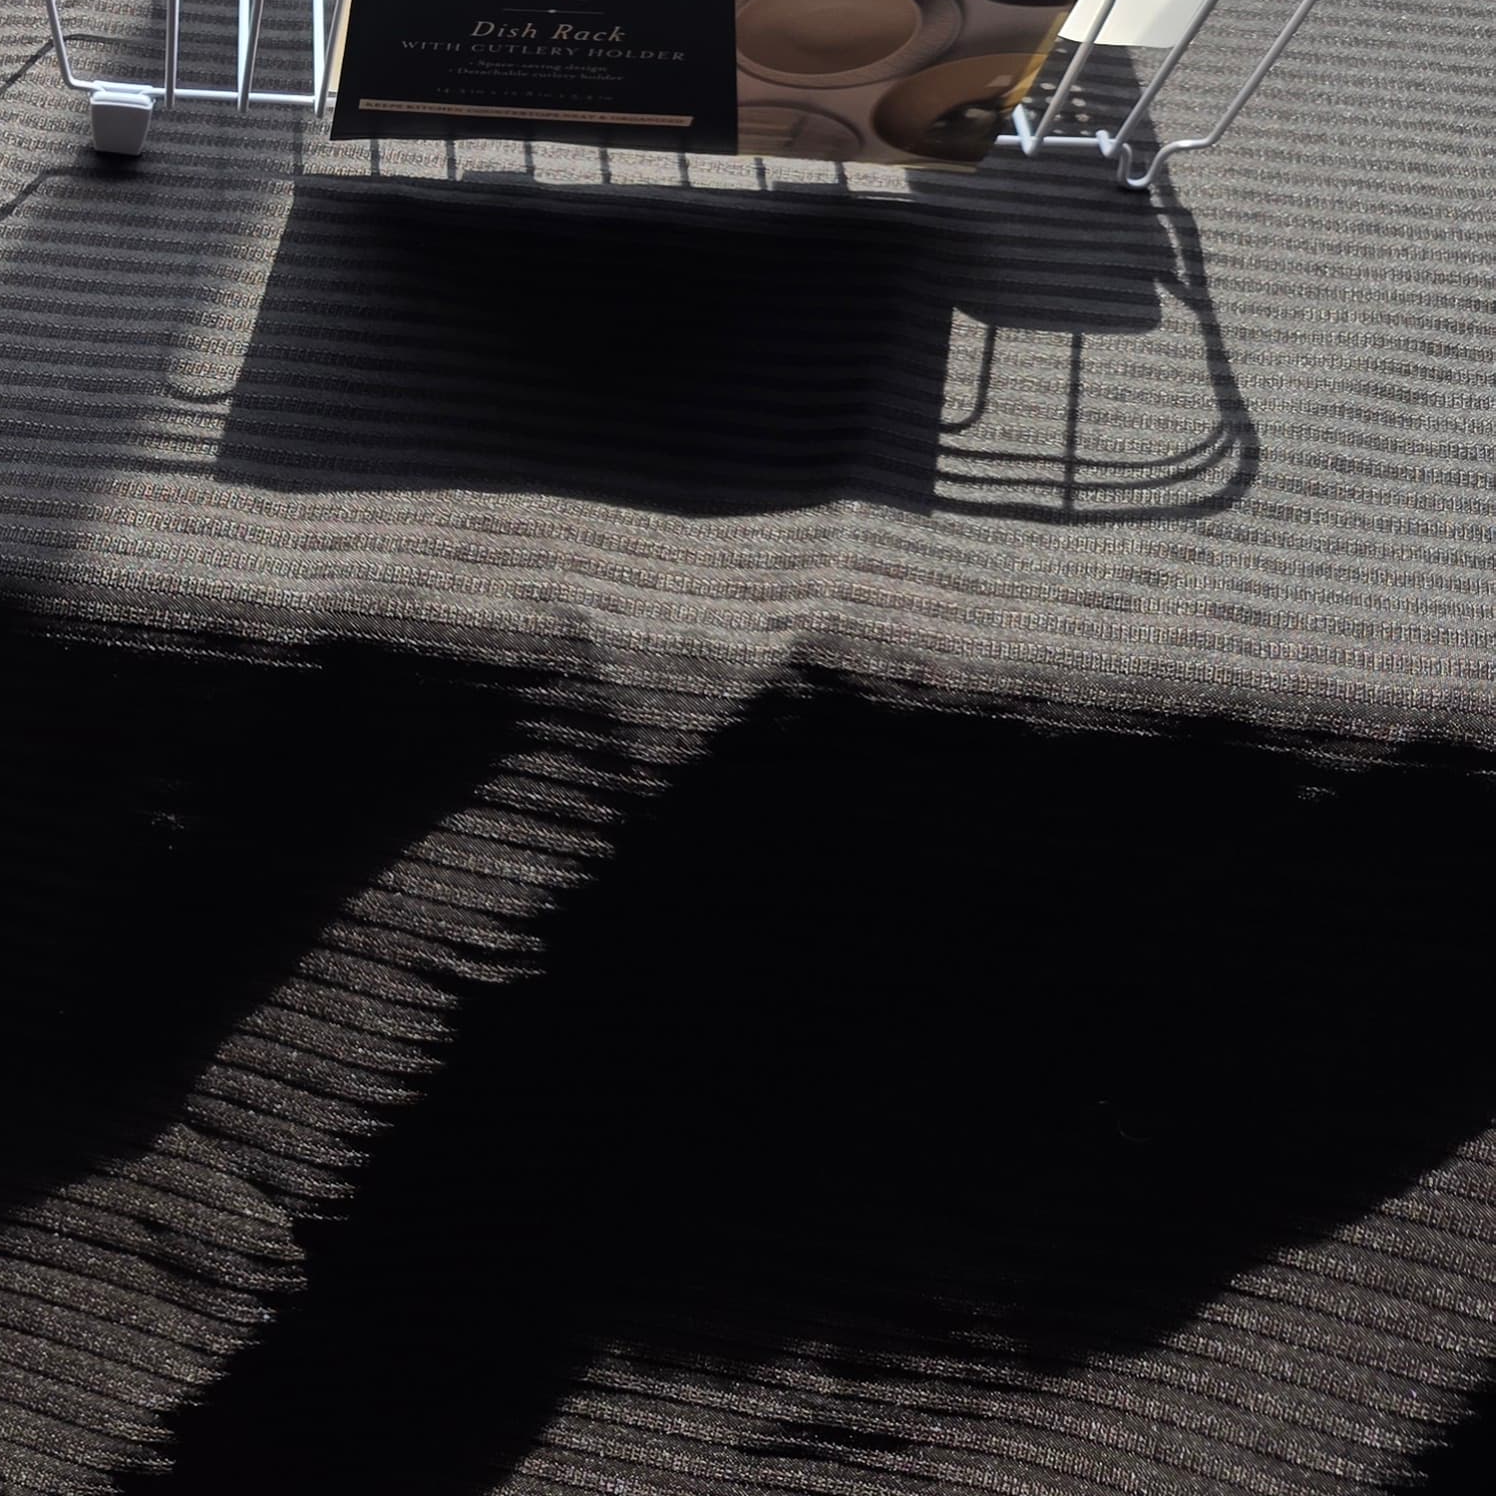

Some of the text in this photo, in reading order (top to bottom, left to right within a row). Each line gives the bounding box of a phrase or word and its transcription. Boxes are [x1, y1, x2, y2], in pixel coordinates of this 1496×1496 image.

[470, 21, 627, 42] Dish Rack
[400, 40, 686, 61] WITH CUTLERY HOLDER
